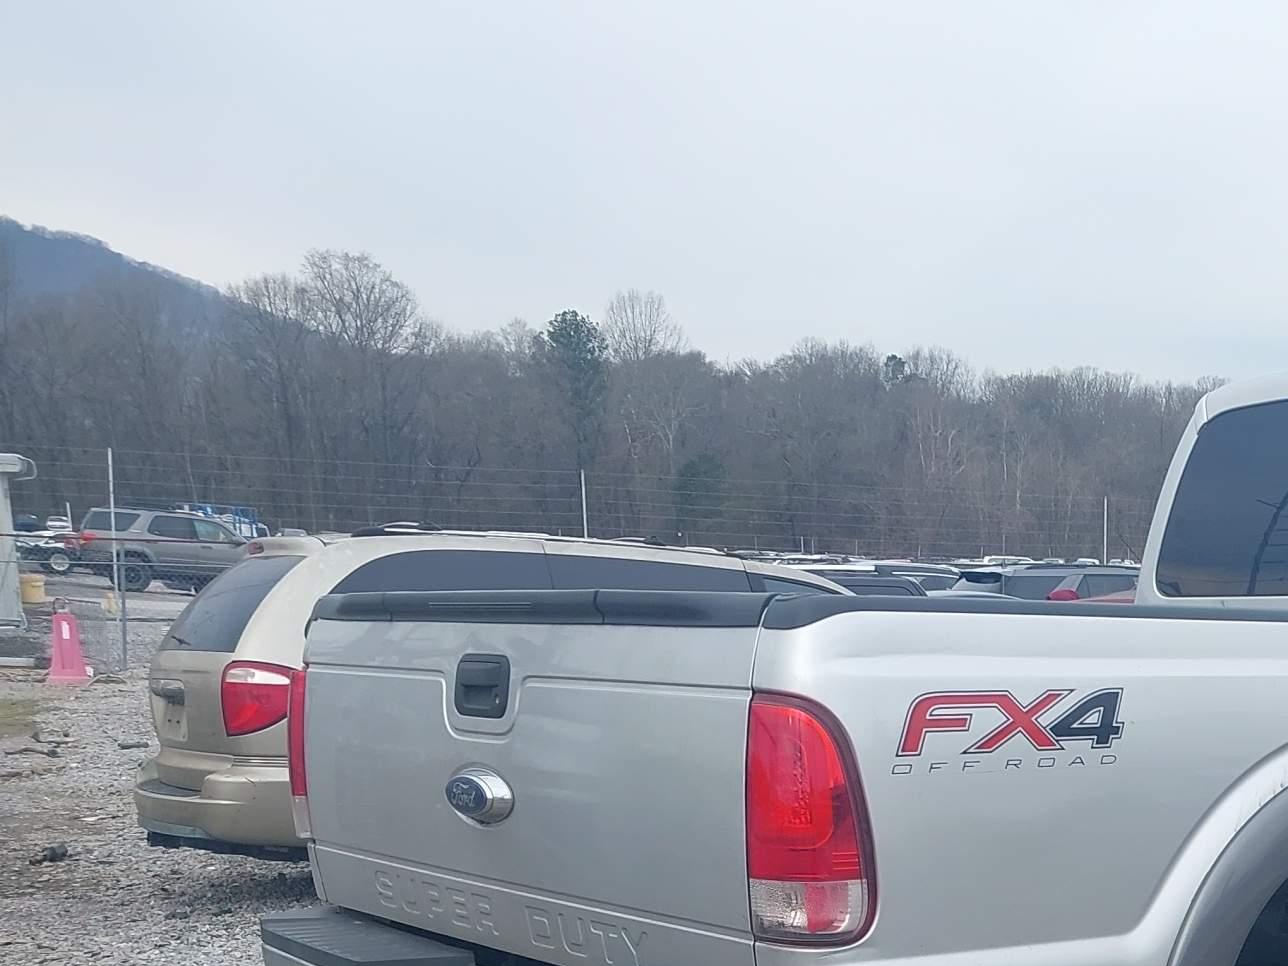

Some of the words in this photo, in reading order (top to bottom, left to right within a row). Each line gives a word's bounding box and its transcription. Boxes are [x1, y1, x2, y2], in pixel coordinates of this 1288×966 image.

[896, 687, 1125, 757] FX4
[891, 760, 981, 775] OFF
[1004, 754, 1118, 770] ROAD
[374, 870, 500, 936] SUPER
